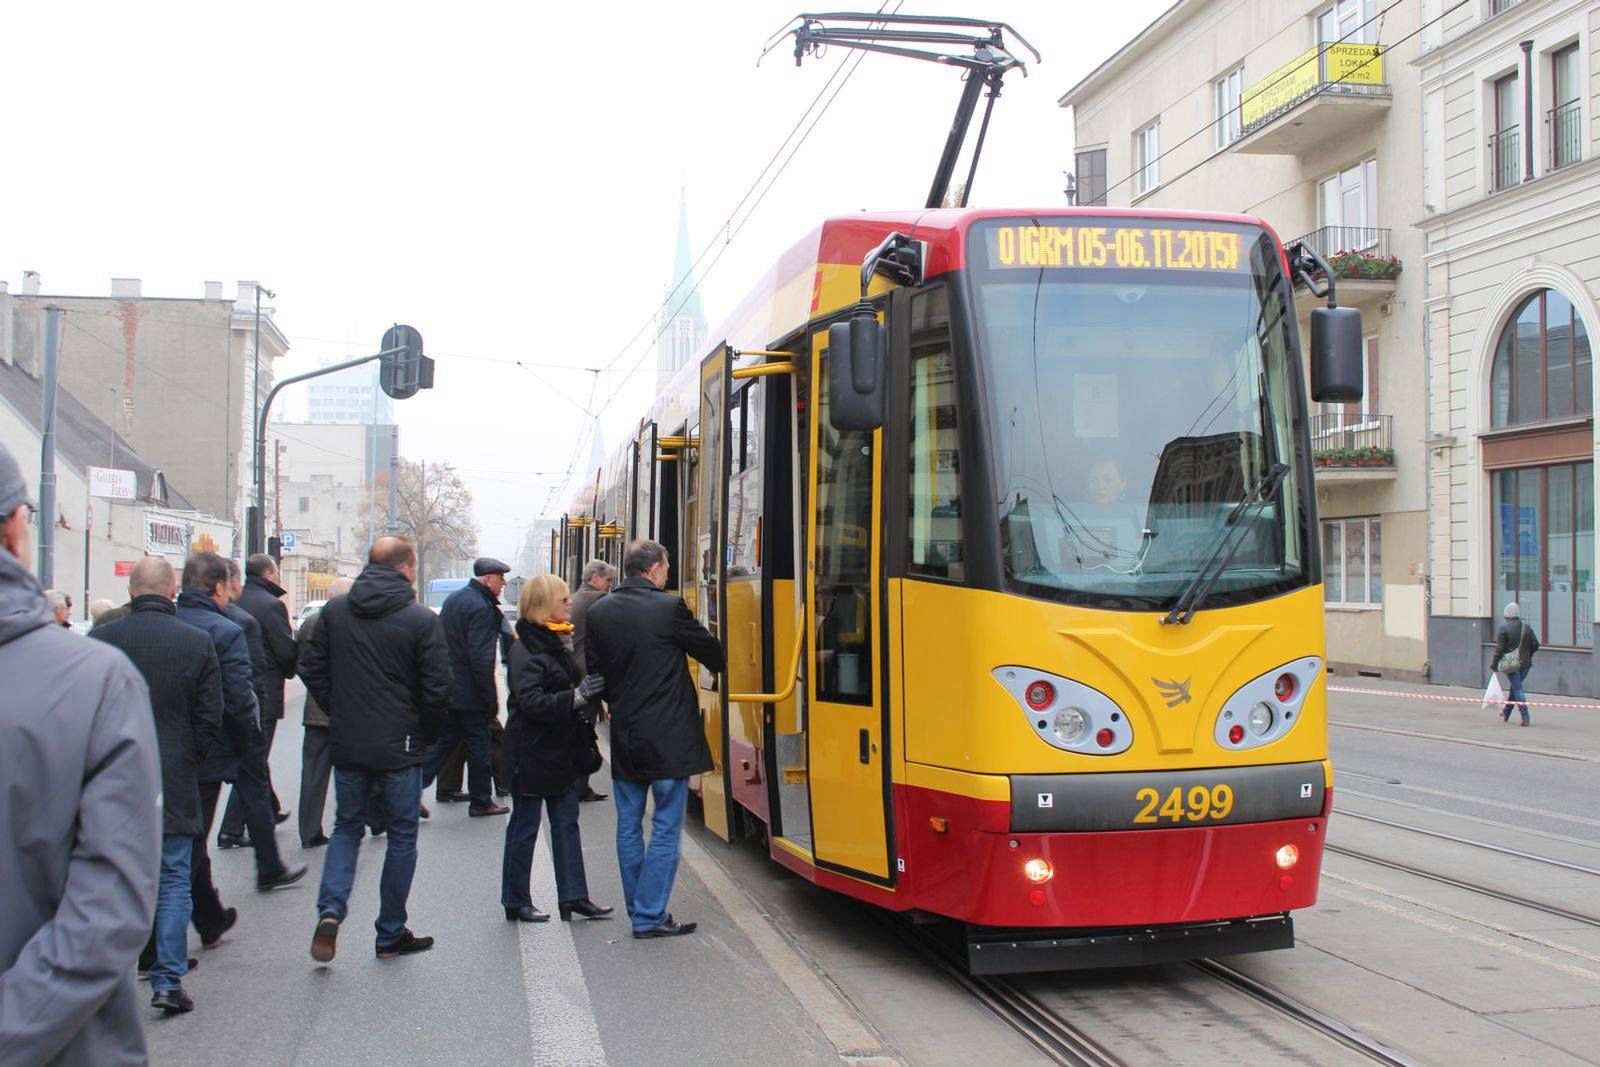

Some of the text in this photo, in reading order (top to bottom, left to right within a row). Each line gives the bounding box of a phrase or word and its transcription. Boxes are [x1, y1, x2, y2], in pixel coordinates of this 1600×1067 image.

[1330, 46, 1381, 57] SPRZEDA
[1340, 59, 1370, 68] LOKAL
[1357, 71, 1370, 80] m2
[1018, 226, 1075, 267] IGKM
[284, 535, 293, 547] P
[1133, 783, 1234, 824] 2499
